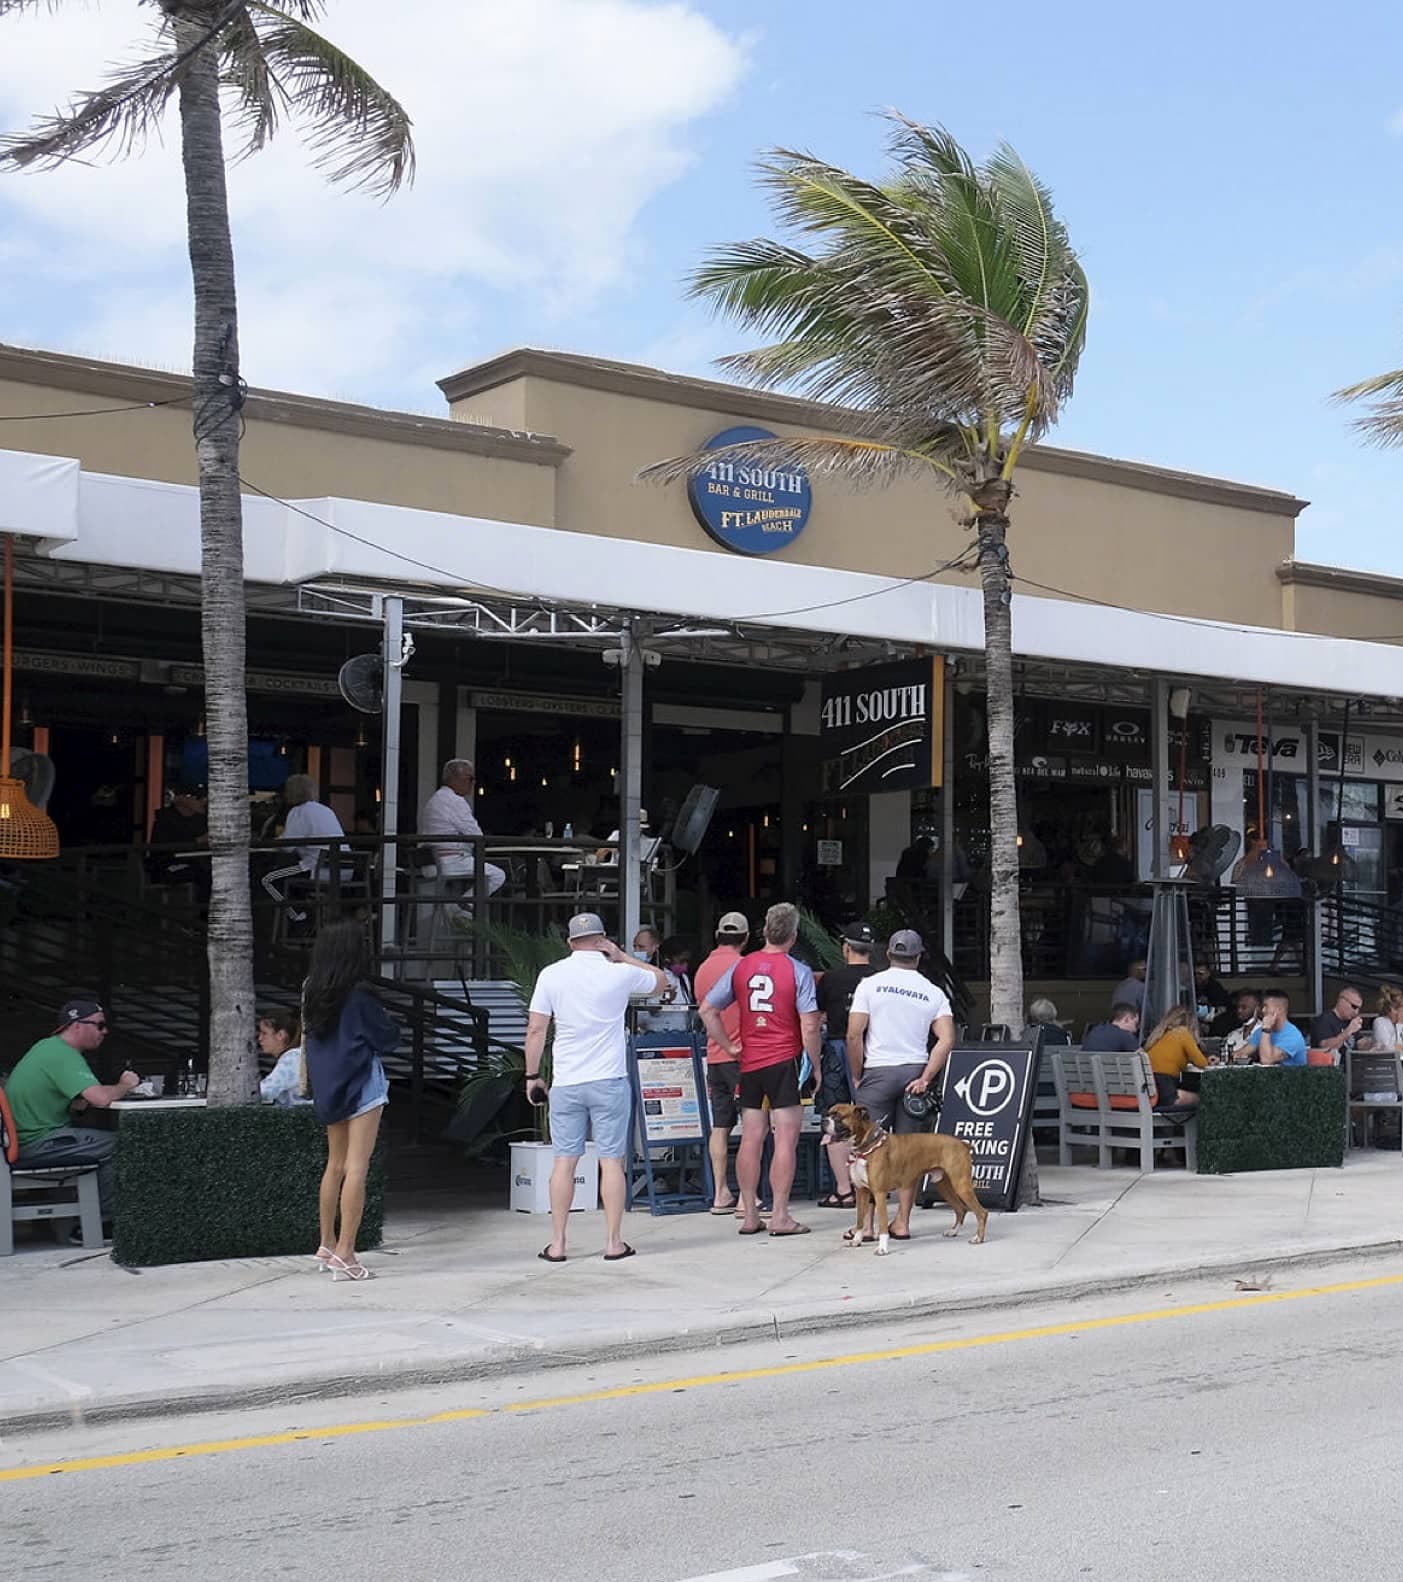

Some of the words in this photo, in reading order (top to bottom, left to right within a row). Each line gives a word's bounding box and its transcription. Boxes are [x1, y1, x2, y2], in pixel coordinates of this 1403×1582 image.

[705, 461, 735, 482] 411
[738, 465, 803, 494] SOUTH
[708, 482, 730, 497] BAR
[733, 487, 741, 498] &
[744, 488, 775, 503] GRILL
[721, 511, 745, 528] FT.
[12, 655, 69, 671] URGERS
[78, 660, 128, 674] WINGS
[265, 678, 330, 692] COCKTAILS
[821, 695, 852, 728] 411
[855, 683, 926, 724] SOUTH
[1235, 733, 1299, 758] Teva
[748, 974, 776, 1013] 2
[978, 1069, 1007, 1107] P
[954, 1121, 994, 1137] FREE
